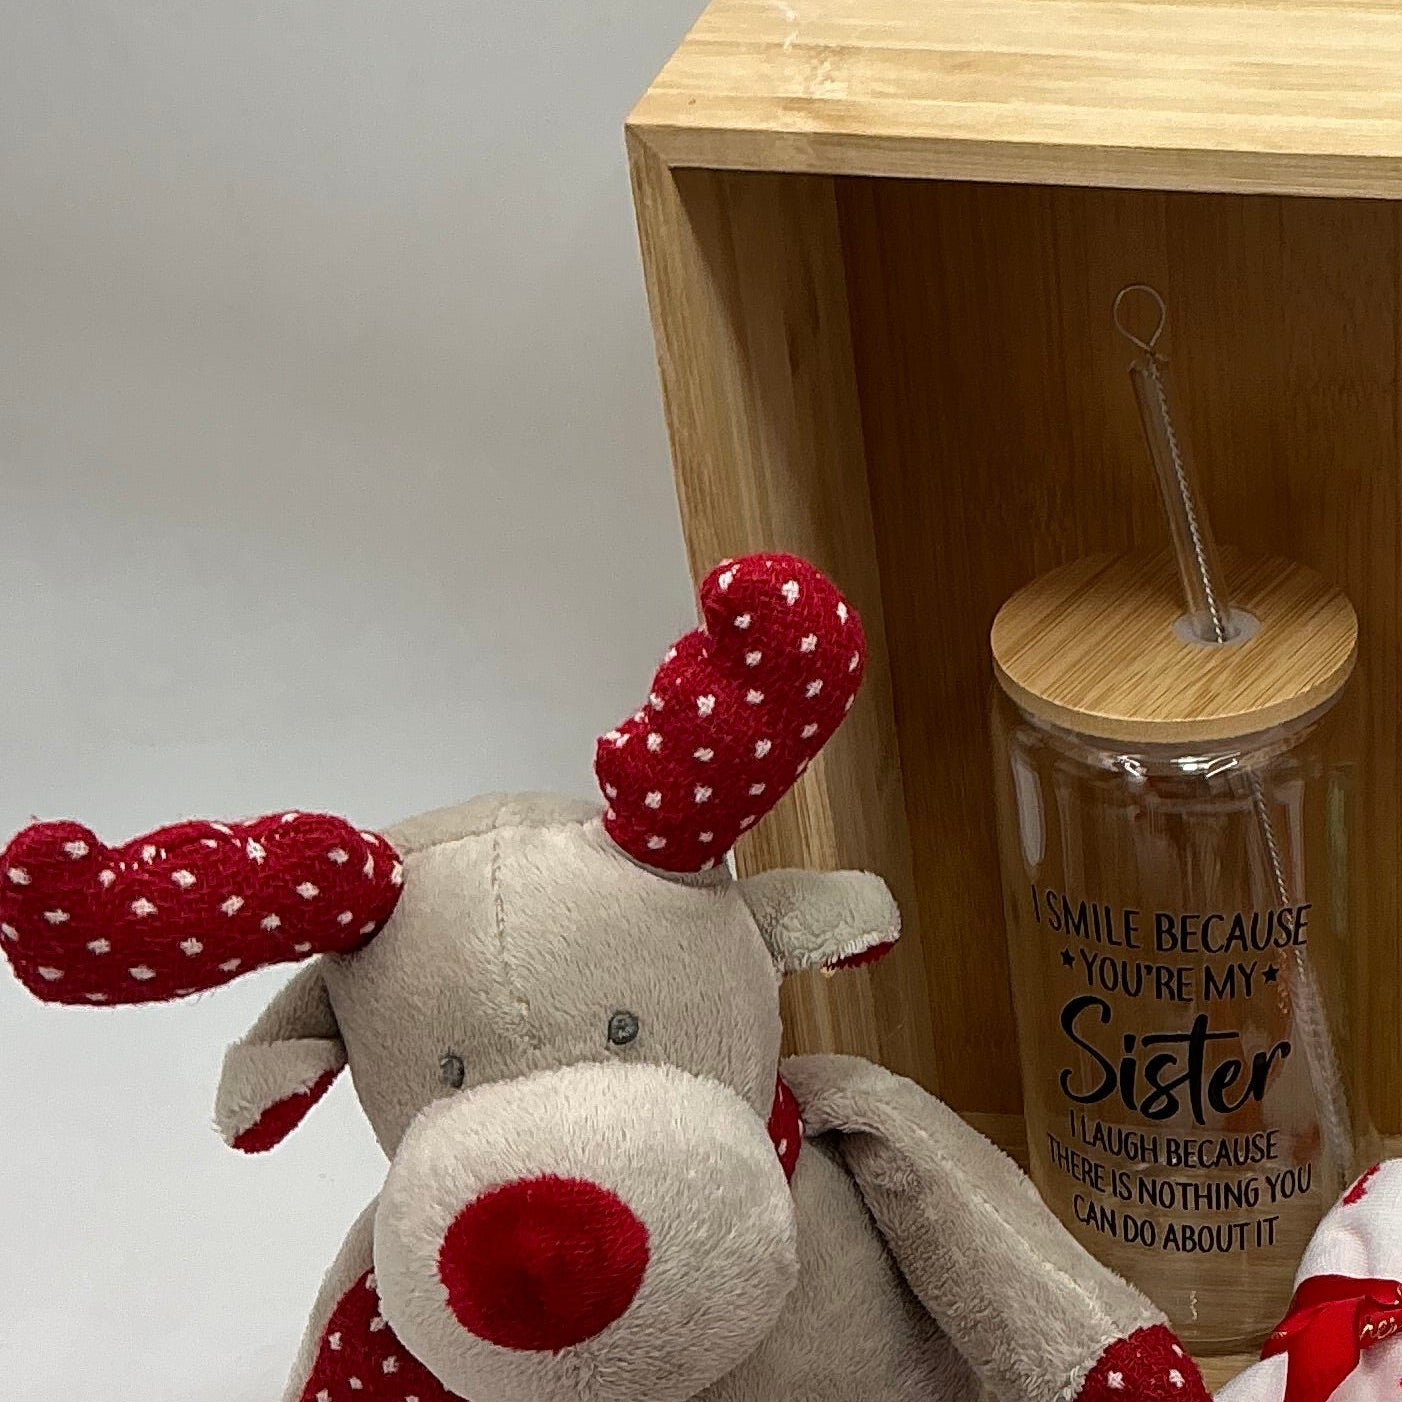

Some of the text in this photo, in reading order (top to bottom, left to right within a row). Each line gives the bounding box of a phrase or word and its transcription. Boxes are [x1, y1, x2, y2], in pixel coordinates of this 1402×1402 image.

[1048, 889, 1313, 954] SMILE BECAUSE
[1079, 948, 1258, 1001] YOU'RE MY
[1060, 995, 1291, 1125] Sister
[1047, 1132, 1313, 1212] THERE IS NOTHING YOU
[1081, 1120, 1281, 1169] LAUGH BECAUSE
[1073, 1194, 1280, 1254] CAN DO ABOUT IT
